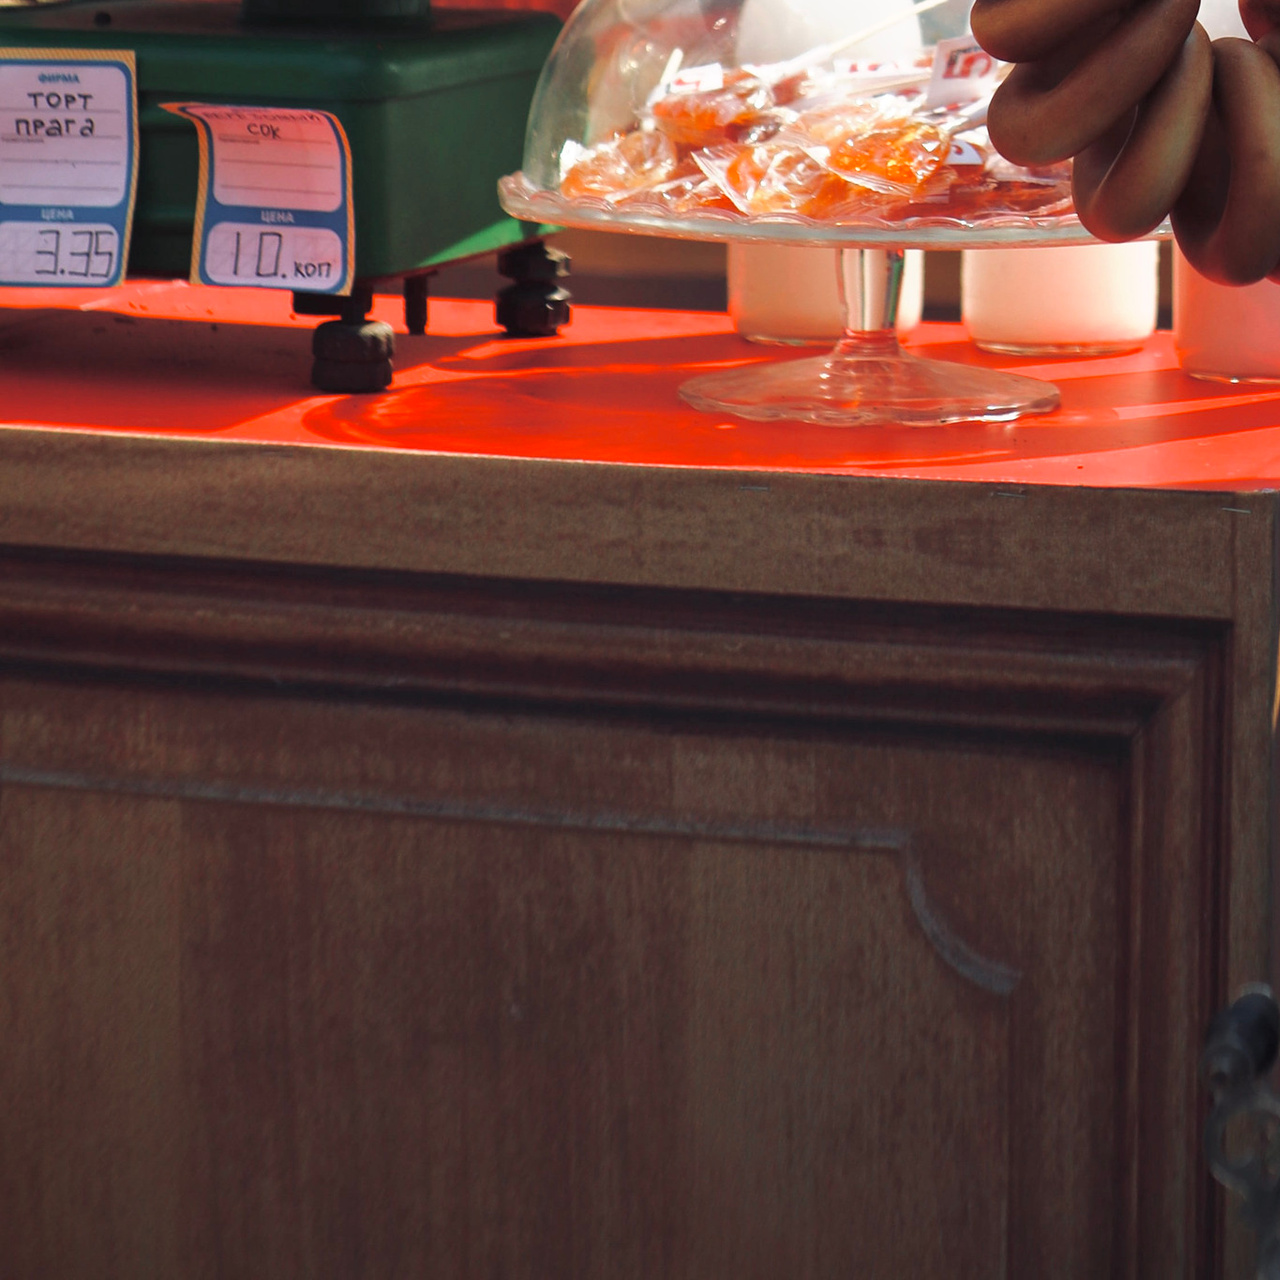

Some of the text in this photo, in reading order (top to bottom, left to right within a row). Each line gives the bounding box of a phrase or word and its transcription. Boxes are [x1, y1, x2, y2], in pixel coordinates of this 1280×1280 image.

[41, 208, 75, 221] ЦЕНА
[260, 210, 295, 224] ЦЕНА
[35, 229, 114, 277] 3.35
[294, 261, 332, 279] коп
